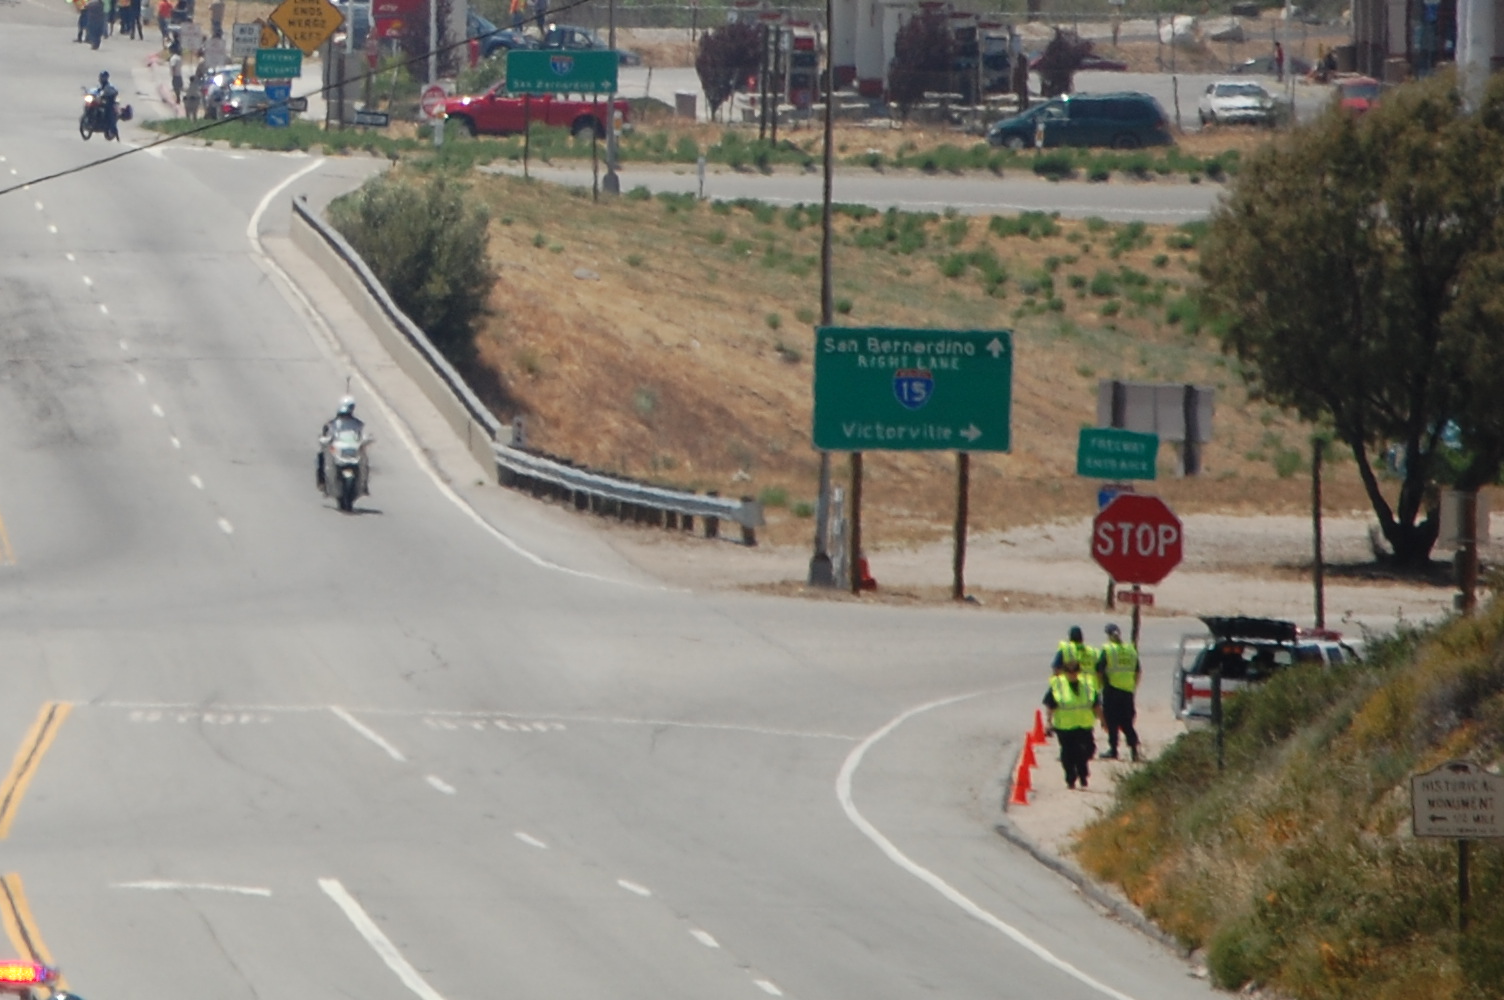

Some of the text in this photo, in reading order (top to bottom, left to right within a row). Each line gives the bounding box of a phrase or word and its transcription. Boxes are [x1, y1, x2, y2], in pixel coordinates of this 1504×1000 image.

[293, 8, 323, 16] ENDS
[288, 19, 326, 28] MERGE
[295, 32, 322, 40] LEFT
[513, 81, 532, 89] San
[824, 336, 976, 356] San Bernardino
[857, 354, 960, 370] RIGHT LANE
[902, 381, 927, 401] 15
[842, 421, 953, 440] Victorville
[1097, 521, 1179, 557] STOP
[1427, 797, 1494, 810] MONUMENT
